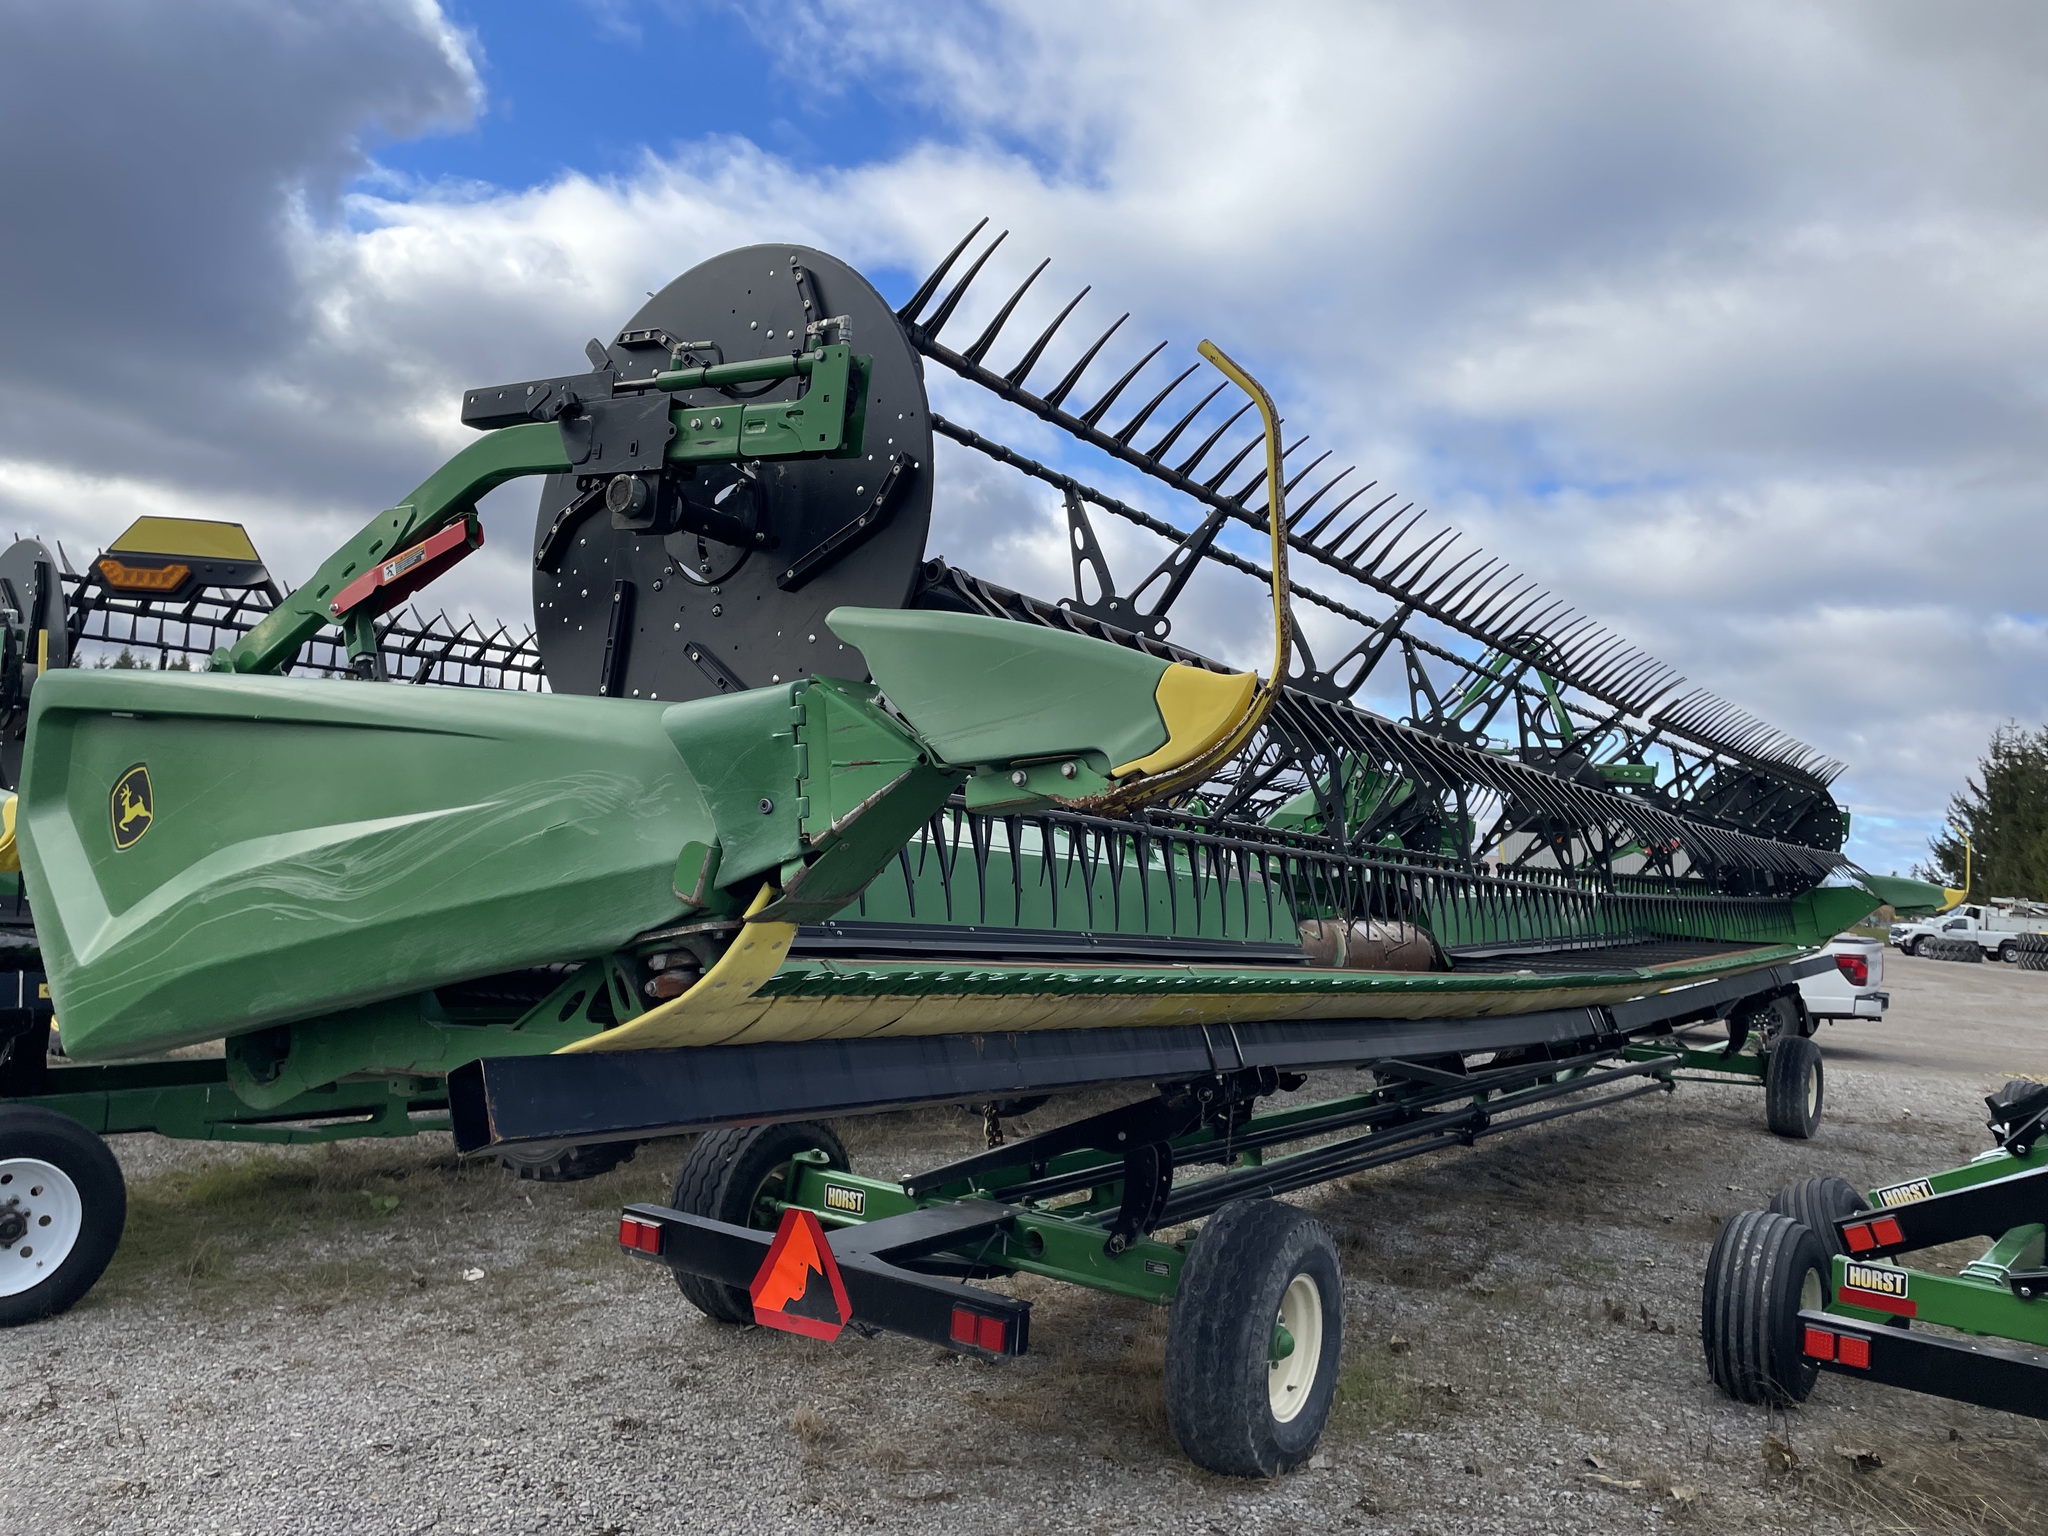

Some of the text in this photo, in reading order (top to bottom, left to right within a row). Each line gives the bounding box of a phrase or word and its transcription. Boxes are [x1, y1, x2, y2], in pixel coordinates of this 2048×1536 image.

[827, 1187, 864, 1211] HORST
[1881, 1181, 1930, 1207] HORST
[1849, 1265, 1905, 1294] HORST
